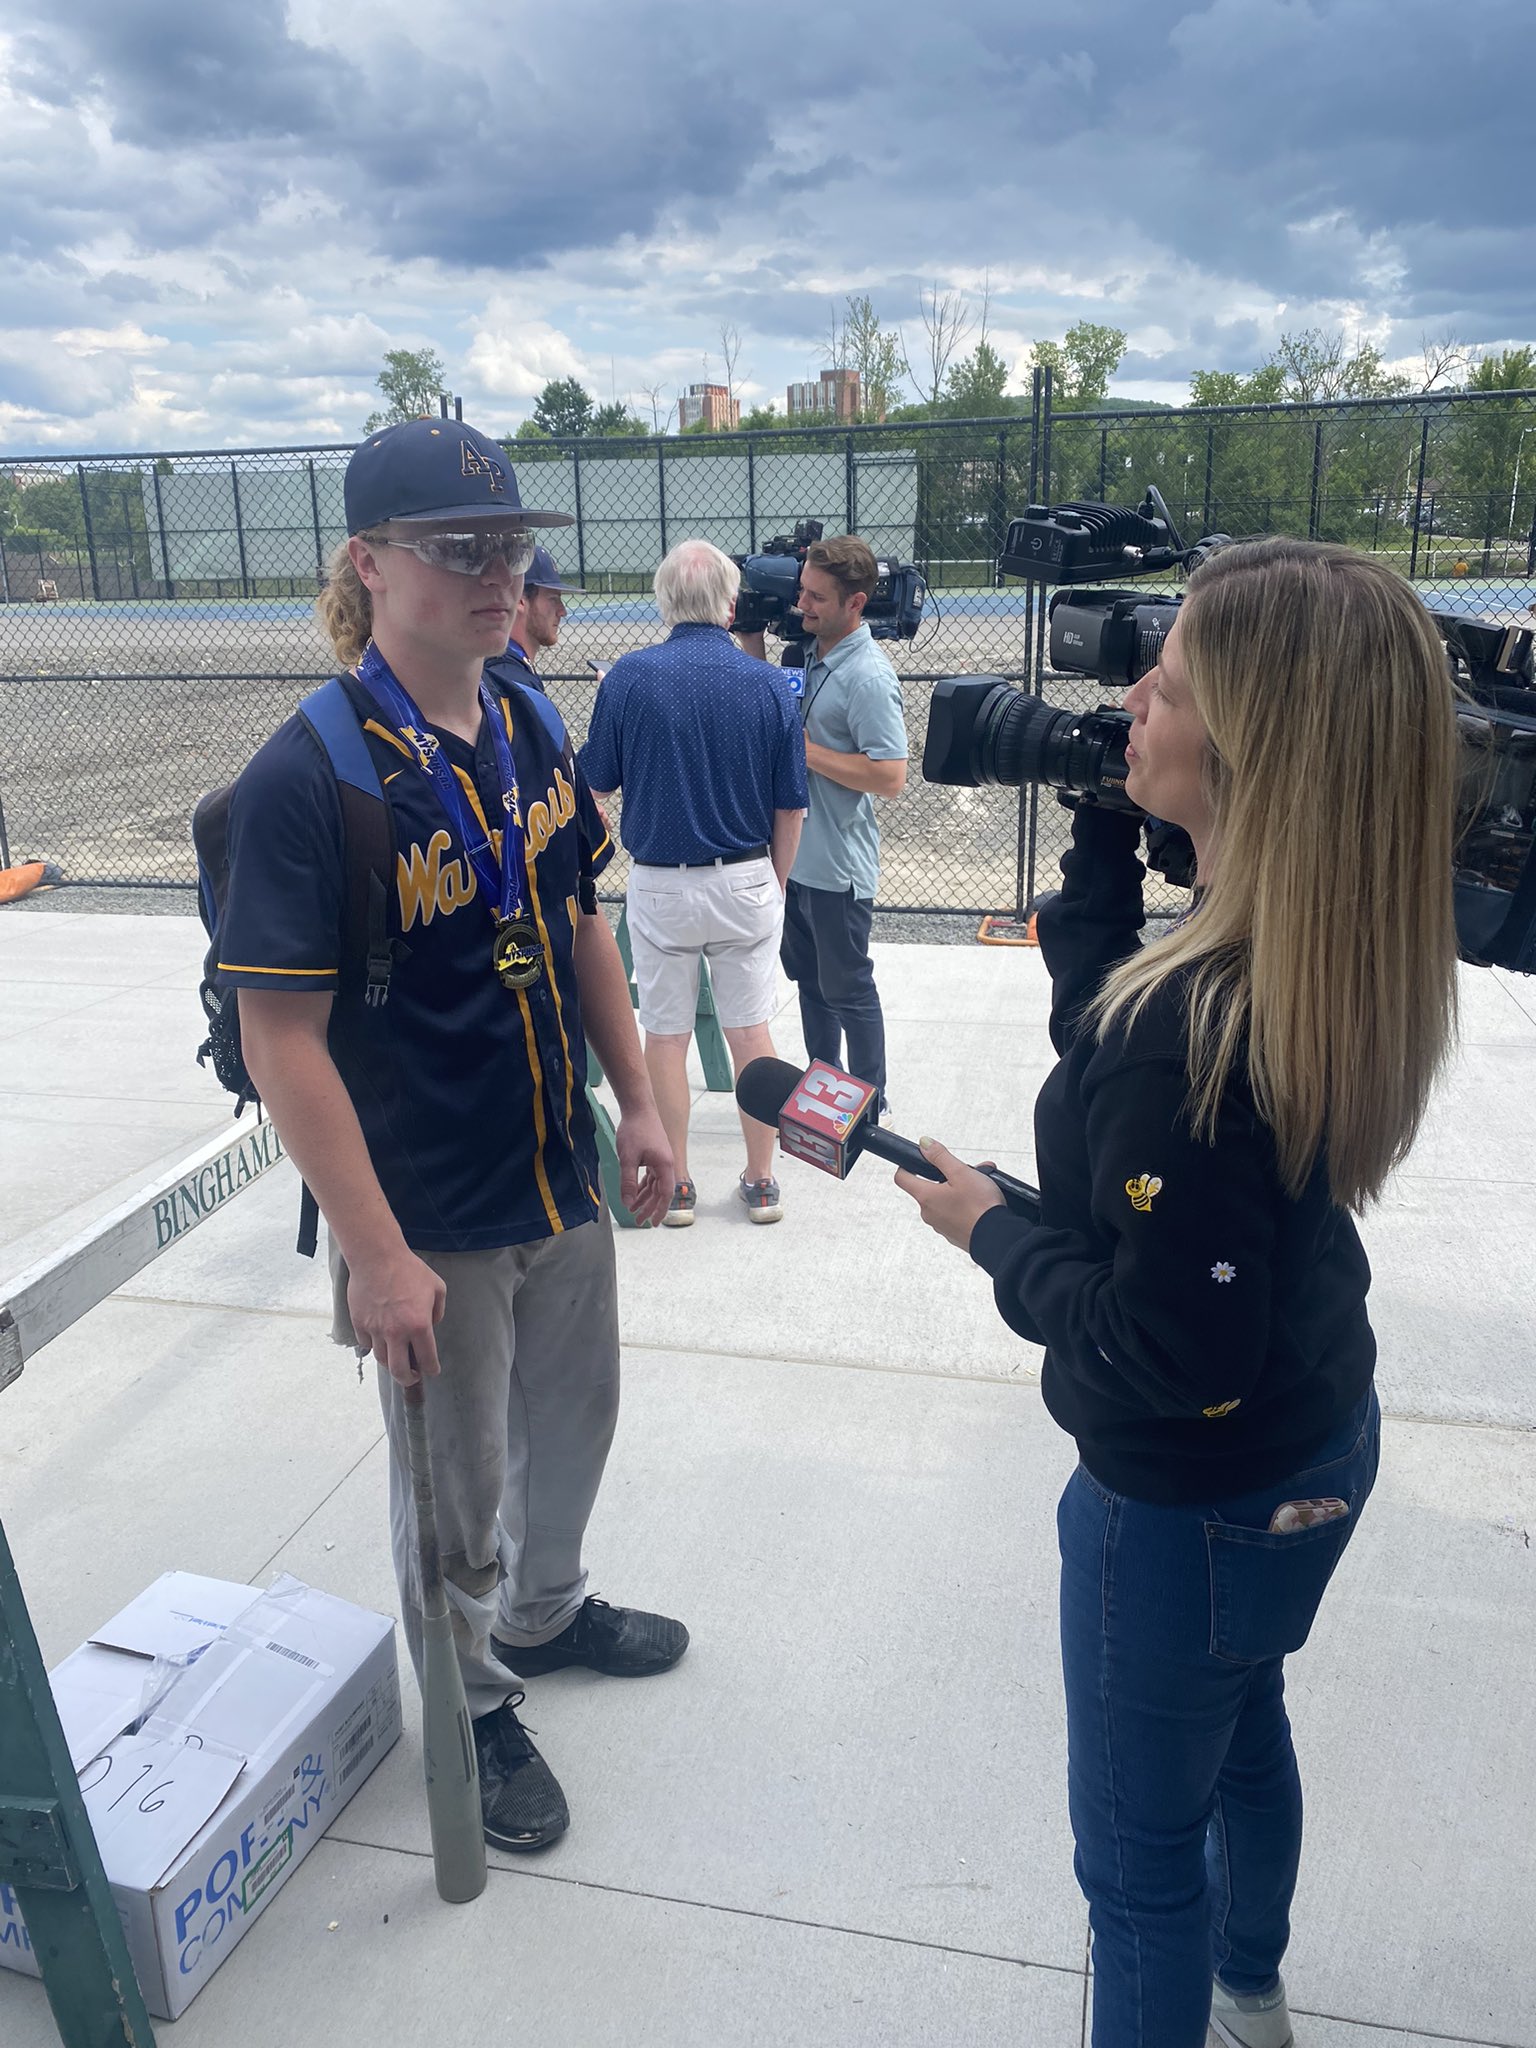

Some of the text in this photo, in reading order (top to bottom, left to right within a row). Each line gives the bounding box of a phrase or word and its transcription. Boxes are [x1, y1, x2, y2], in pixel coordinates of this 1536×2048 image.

[460, 439, 506, 494] AP
[781, 668, 804, 677] NEWS
[396, 766, 577, 933] Waors
[795, 1068, 865, 1121] 13
[783, 1122, 838, 1164] 13
[301, 1753, 325, 1795] &
